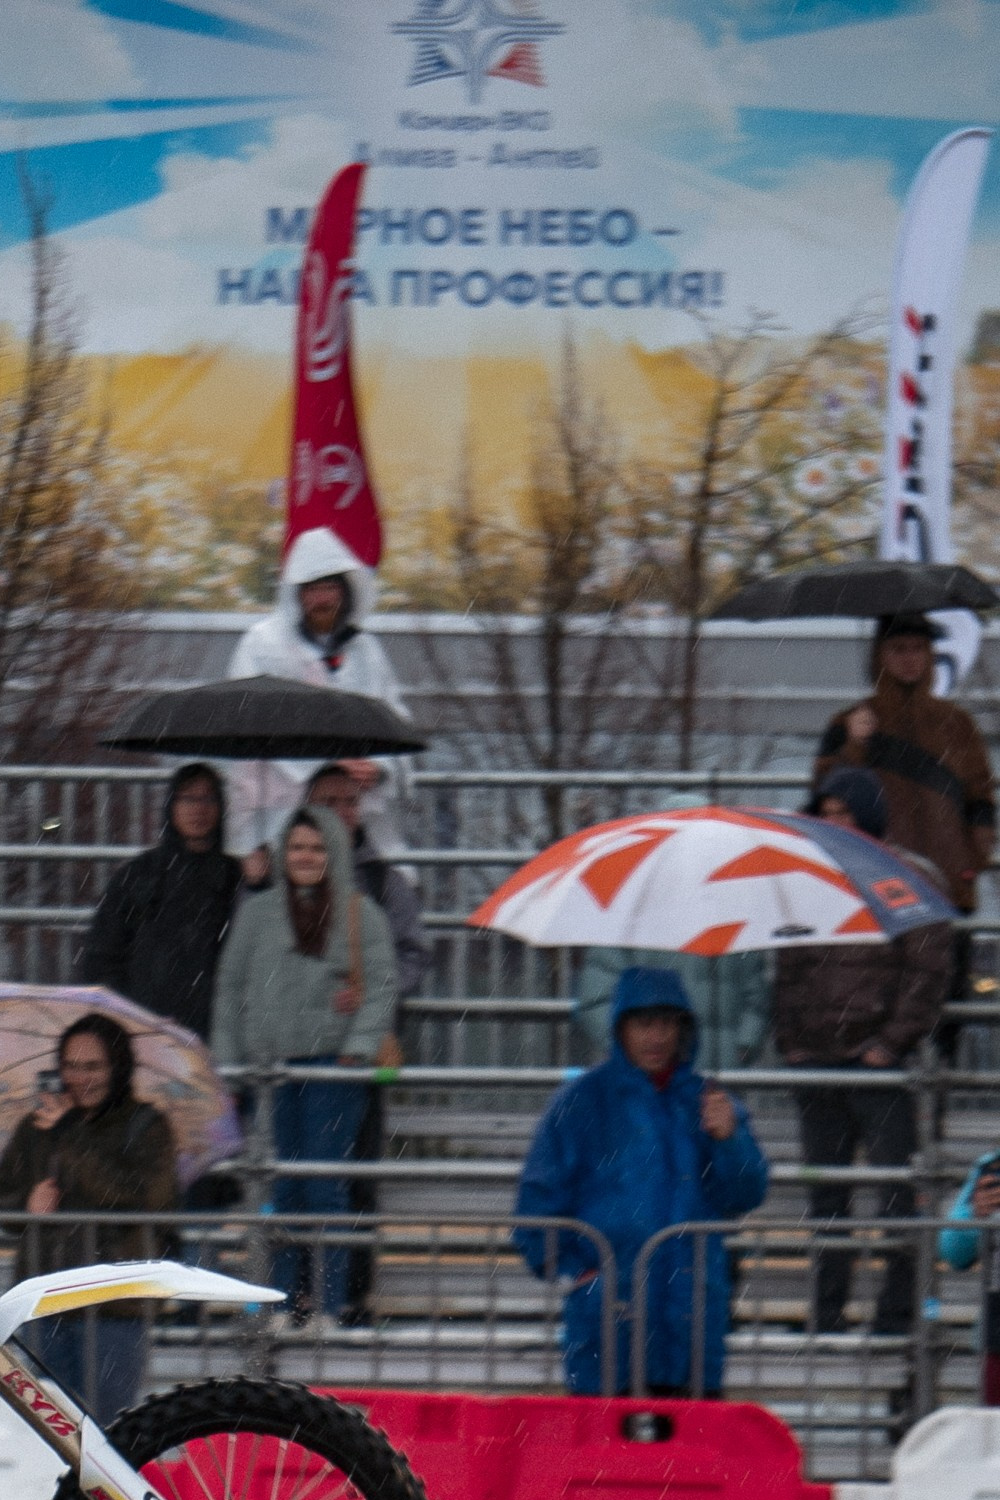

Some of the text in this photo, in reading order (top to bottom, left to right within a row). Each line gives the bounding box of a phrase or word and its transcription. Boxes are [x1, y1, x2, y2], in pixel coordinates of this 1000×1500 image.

[266, 207, 486, 247] МРНОЕ
[500, 207, 638, 247] НЕБО
[216, 266, 725, 308] НАА ПРОФЕССИЯ!
